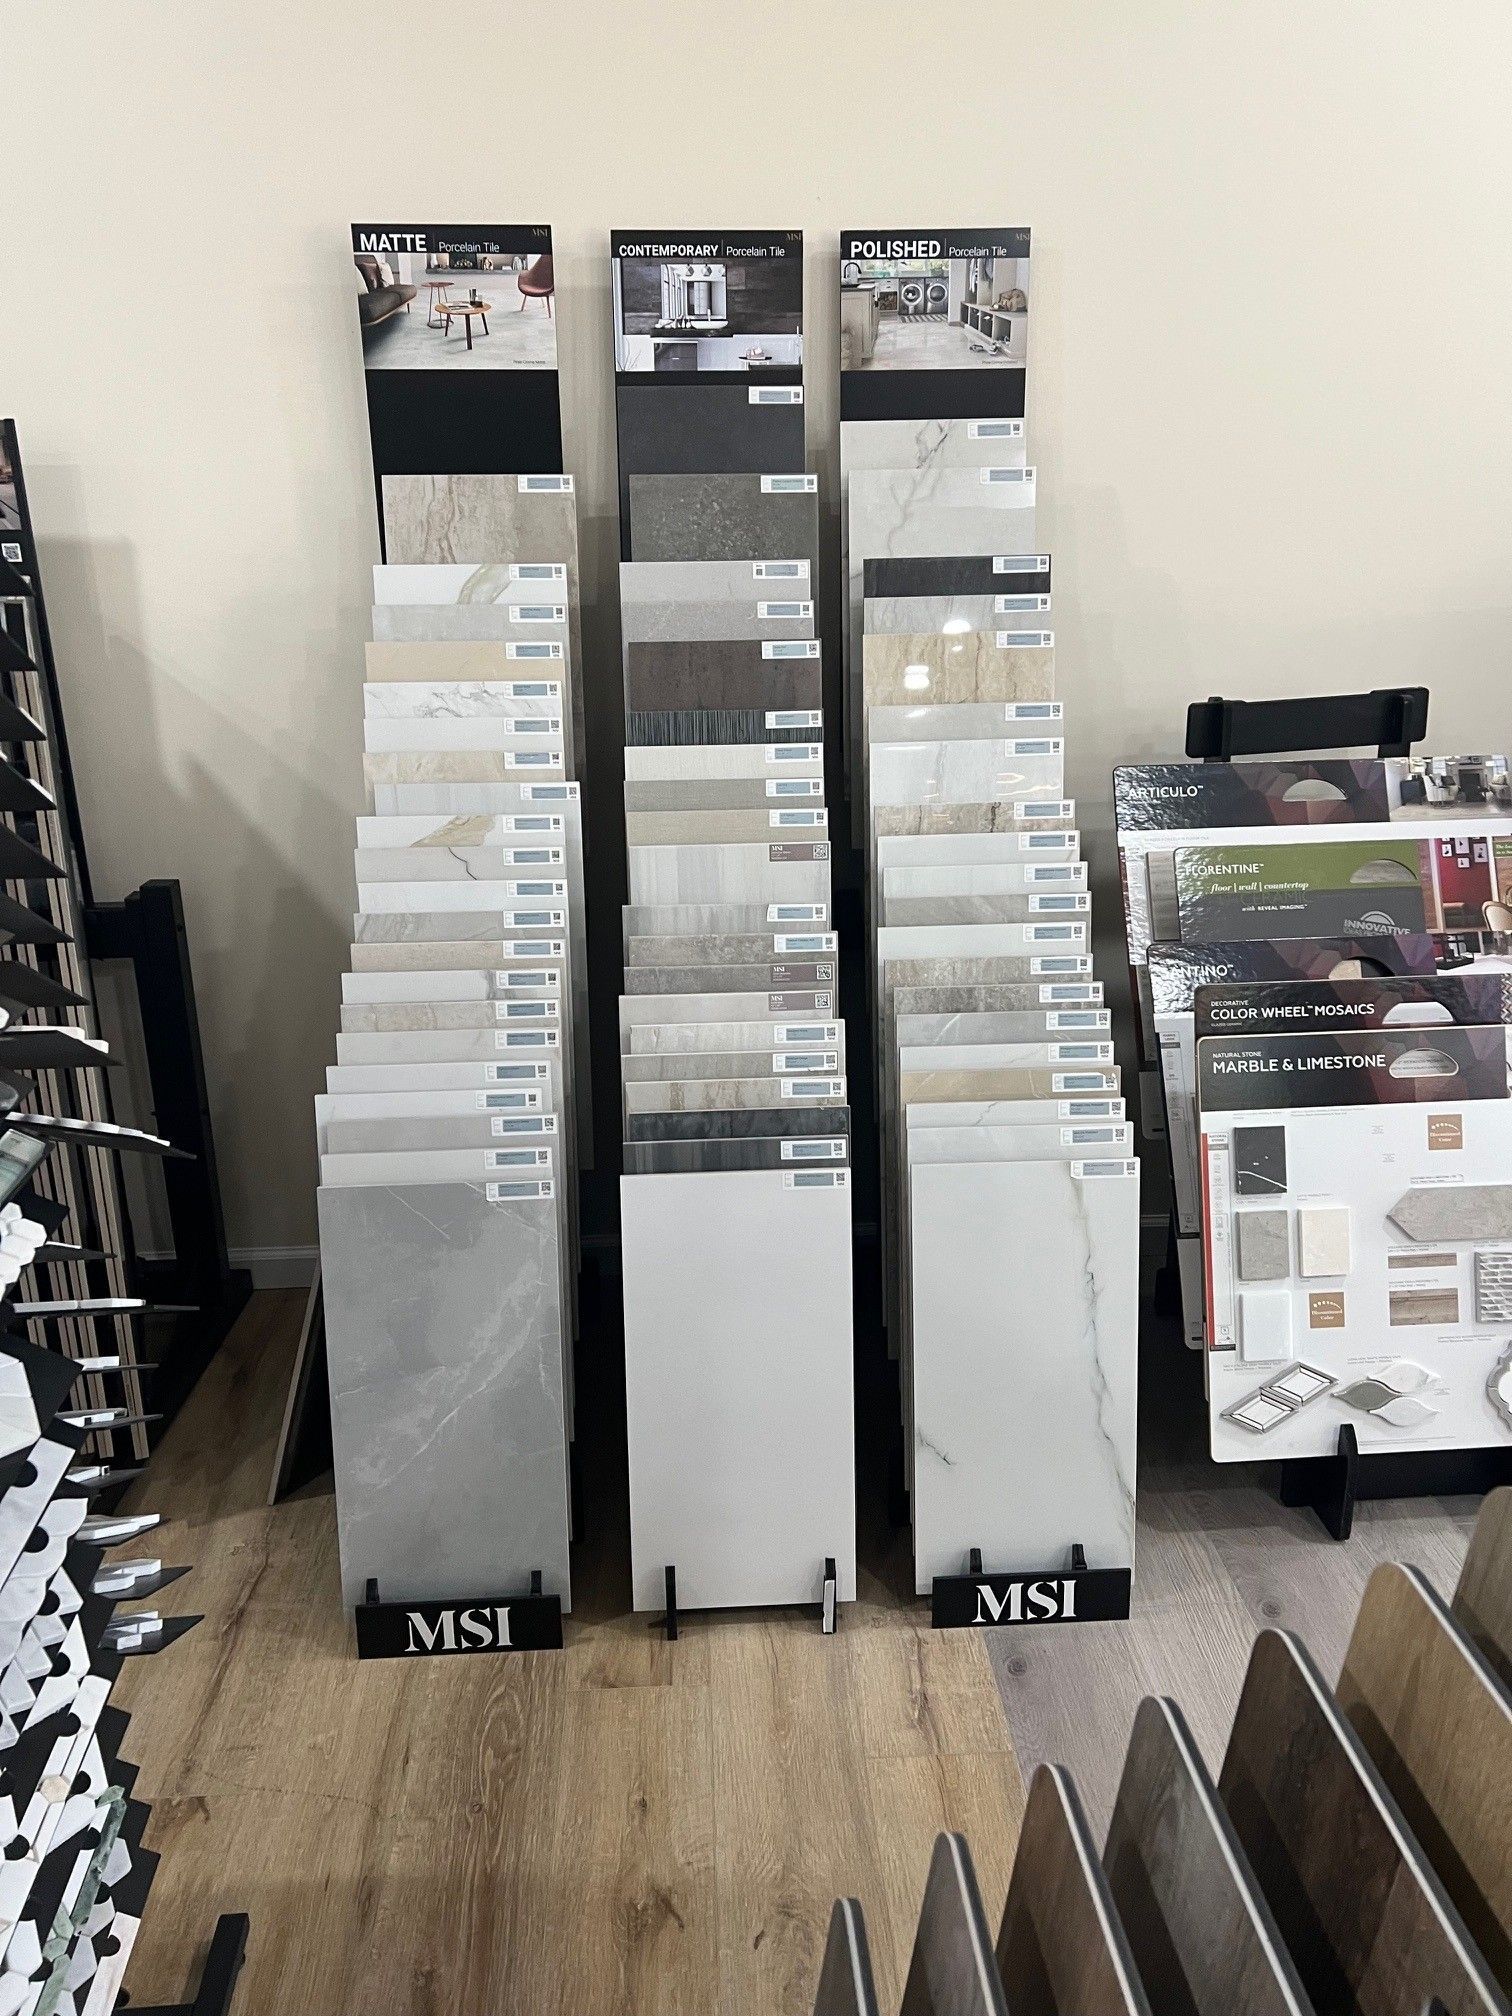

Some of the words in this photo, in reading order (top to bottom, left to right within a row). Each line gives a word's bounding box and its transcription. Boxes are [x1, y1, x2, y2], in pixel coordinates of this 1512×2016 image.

[359, 233, 427, 252] MATTE
[438, 241, 481, 253] Porcelain
[483, 241, 500, 253] Tile
[619, 245, 719, 257] CONTEMPORARY
[726, 246, 767, 257] Porcelain
[769, 246, 785, 257] Tile
[850, 240, 941, 258] POLISHED
[948, 246, 989, 257] Porcelain
[991, 246, 1007, 257] Tile
[1210, 883, 1233, 895] floor
[1238, 882, 1257, 891] wall
[1263, 882, 1309, 894] countertop
[1344, 919, 1411, 935] INNOVATIVE
[1210, 999, 1249, 1007] DECORATIVE
[1210, 1007, 1258, 1021] COLOR
[1314, 1003, 1375, 1017] MOSAICS
[1212, 1051, 1240, 1059] NATURAL
[1241, 1050, 1262, 1058] STONE
[1213, 1058, 1278, 1074] MARBLE
[1282, 1057, 1294, 1071] &
[1297, 1054, 1386, 1071] LIMESTONE
[971, 1578, 1078, 1624] MSI
[404, 1605, 514, 1653] MSI
